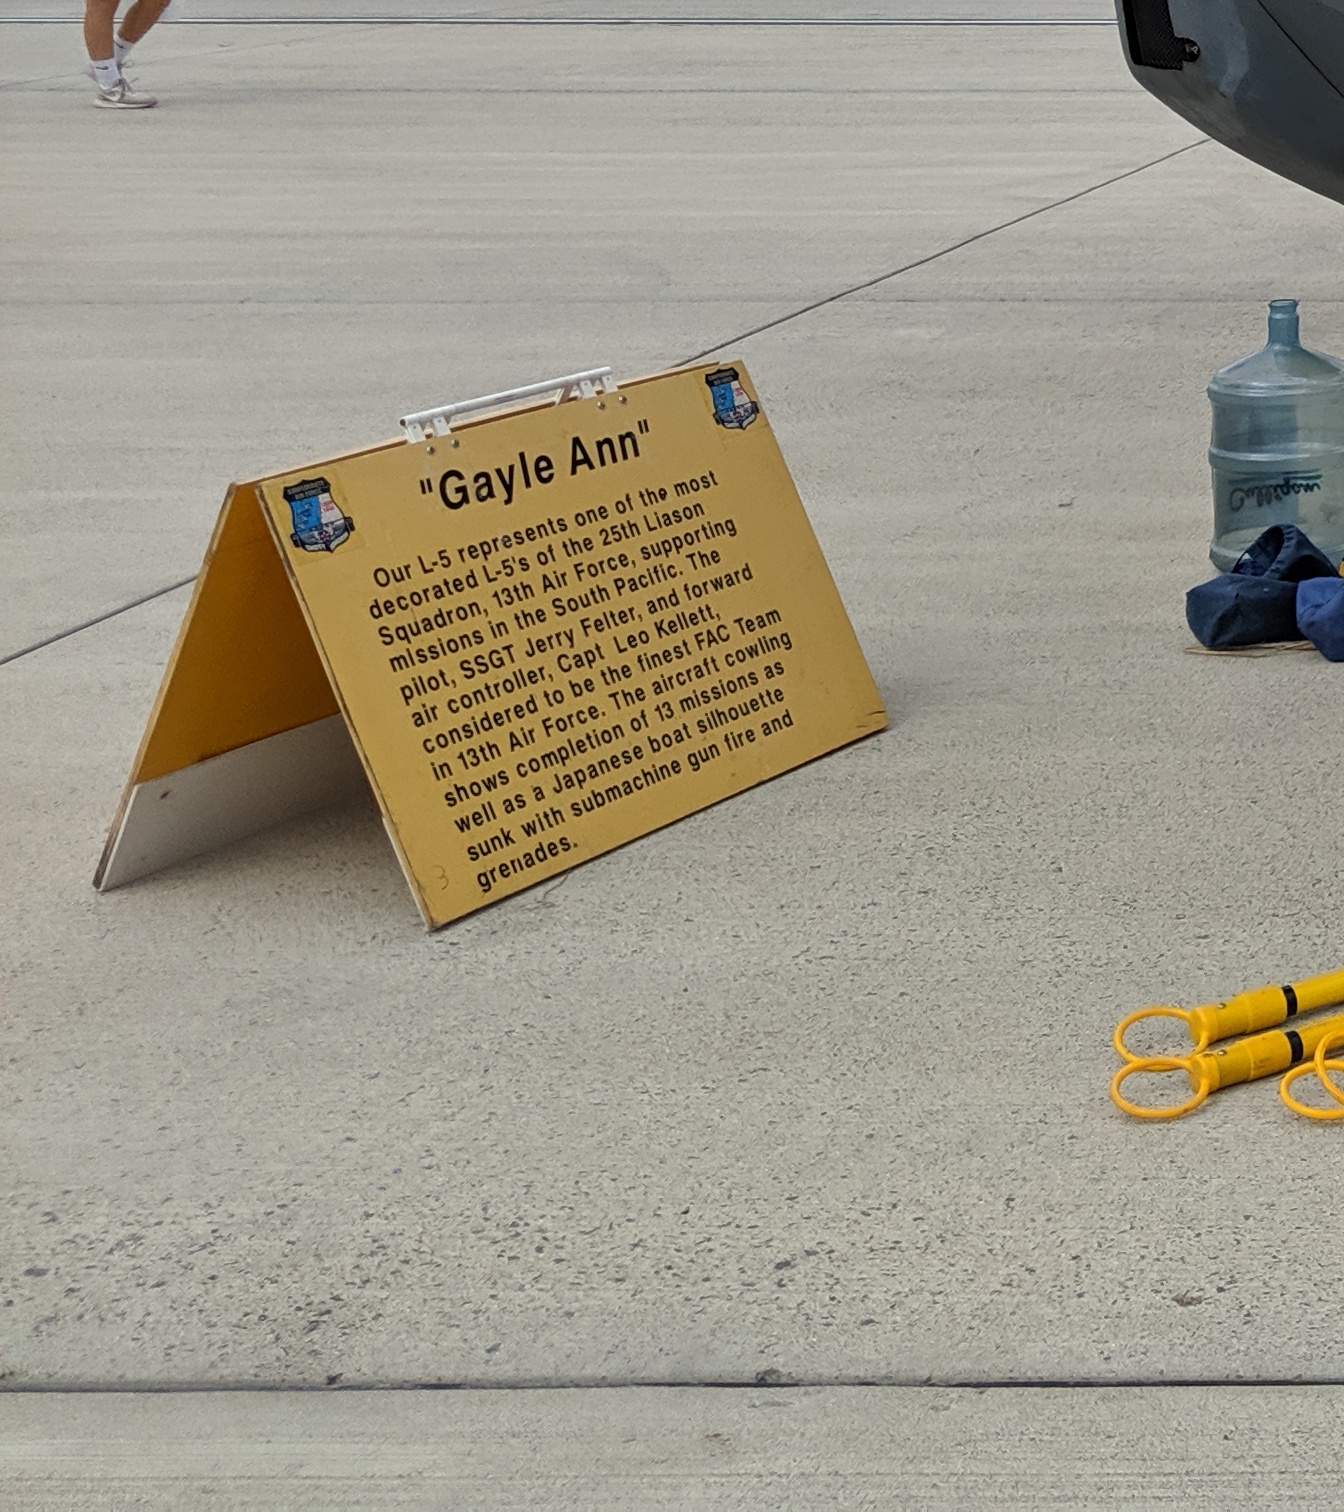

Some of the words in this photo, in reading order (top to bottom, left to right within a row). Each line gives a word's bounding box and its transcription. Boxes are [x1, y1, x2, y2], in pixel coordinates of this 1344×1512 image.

[373, 563, 412, 588] Our
[417, 549, 452, 575] L-5
[457, 517, 568, 563] represents
[574, 505, 609, 527] one
[614, 493, 634, 515] of
[638, 487, 668, 507] the
[673, 470, 719, 498] most
[419, 451, 555, 511] "Gayle
[570, 418, 650, 476] Ann"
[369, 568, 480, 620] decorated
[481, 556, 531, 584] L-5's
[536, 543, 557, 566] of
[561, 537, 595, 558] the
[598, 519, 641, 547] 25th
[642, 502, 705, 532] Liason
[378, 601, 489, 647] Squadron,
[492, 581, 536, 609] 13th
[541, 570, 568, 594] Air
[573, 553, 637, 582] Force,
[640, 518, 738, 561] supporting
[487, 620, 510, 639] in
[513, 608, 547, 630] the
[551, 584, 611, 617] South
[612, 563, 684, 597] Pacific.
[685, 550, 721, 571] The
[399, 668, 457, 707] pilot,
[459, 643, 516, 680] SSGT
[524, 628, 575, 658] Jerry
[579, 606, 643, 638] Felter,
[646, 587, 681, 615] and
[683, 562, 754, 601] forward
[411, 702, 439, 728] air
[447, 665, 554, 714] controller,
[556, 642, 606, 673] Capt
[613, 630, 650, 654] Leo
[653, 603, 721, 639] Kellett,
[422, 693, 539, 754] considered
[543, 689, 565, 708] to
[568, 678, 596, 698] be
[600, 664, 633, 687] the
[637, 639, 692, 673] finest
[693, 624, 731, 652] FAC
[733, 609, 782, 636] Team
[430, 761, 454, 781] in
[457, 741, 502, 770] 13th
[508, 726, 536, 753] Air
[541, 705, 607, 738] Force.
[607, 687, 647, 711] The
[651, 655, 721, 696] aircraft
[724, 632, 793, 668] cowling
[444, 770, 510, 808] shows
[516, 724, 626, 778] completion
[629, 708, 649, 733] of
[654, 701, 675, 722] 13
[678, 671, 759, 713] missions
[763, 661, 785, 680] as
[453, 800, 497, 833] well
[502, 793, 527, 815] as
[532, 785, 546, 802] a
[552, 745, 644, 794] Japanese
[646, 722, 693, 754] boat
[696, 688, 785, 735] silhouette
[466, 827, 517, 862] sunk
[520, 806, 566, 838] with
[570, 759, 682, 818] submachine
[687, 743, 721, 772] gun
[723, 728, 756, 752] fire
[760, 708, 794, 737] and
[476, 836, 578, 893] grenades.
